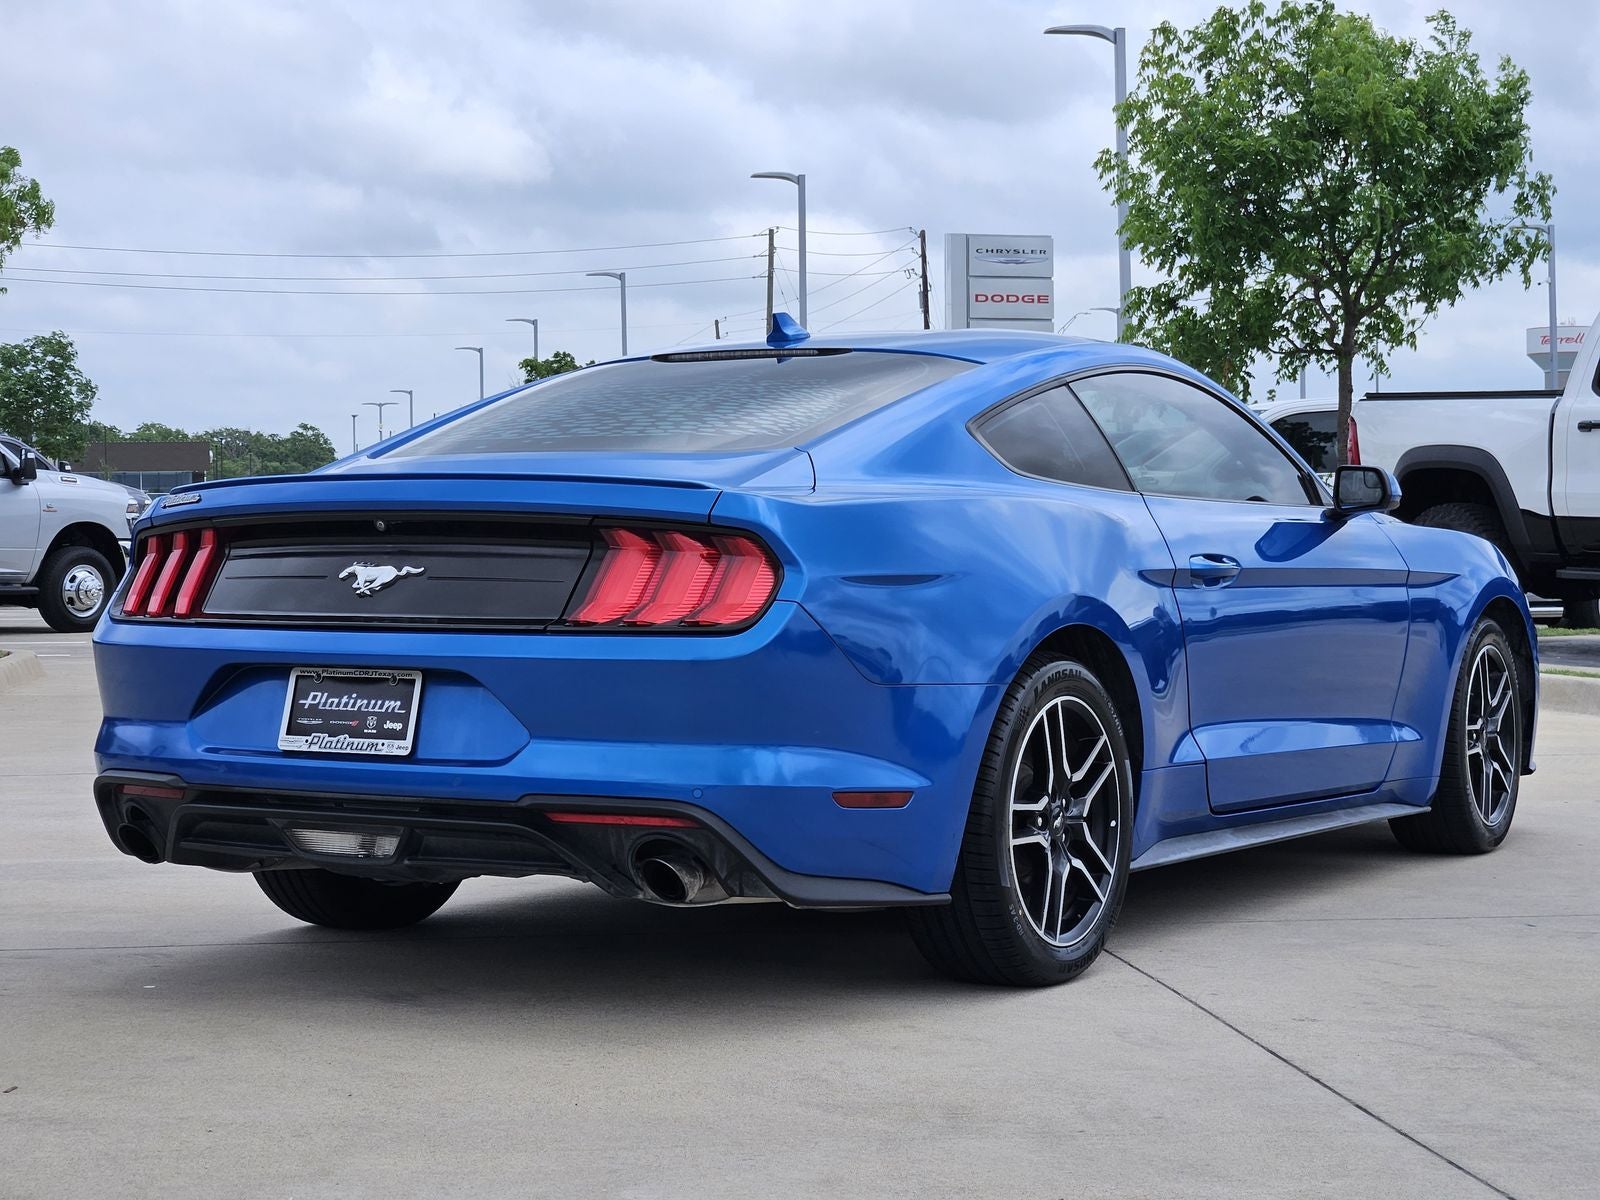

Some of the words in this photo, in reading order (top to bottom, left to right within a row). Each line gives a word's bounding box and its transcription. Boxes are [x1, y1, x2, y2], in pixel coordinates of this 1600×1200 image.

[975, 294, 1049, 304] DODGE
[1540, 332, 1584, 345] Terell
[298, 692, 406, 714] Platinum
[384, 720, 402, 731] Jeep
[308, 734, 384, 752] Platinum
